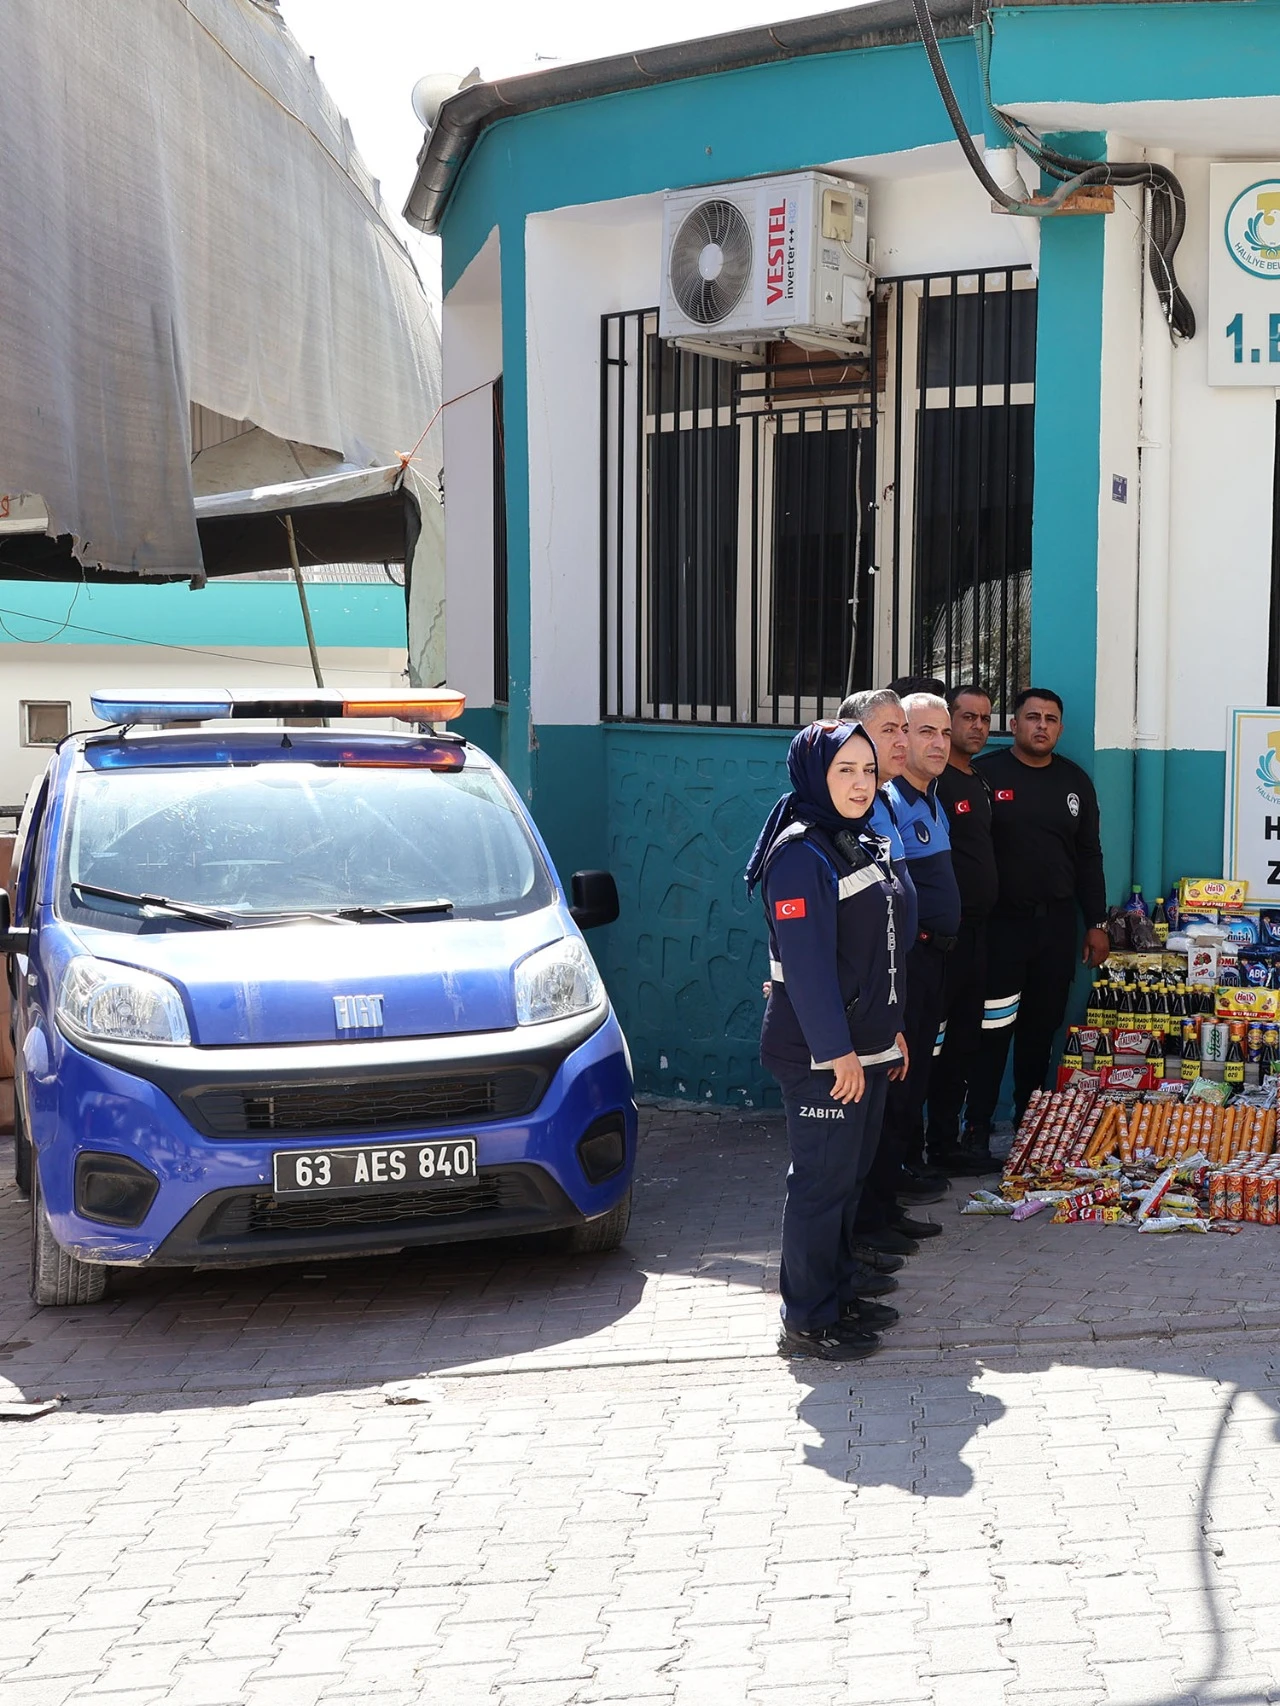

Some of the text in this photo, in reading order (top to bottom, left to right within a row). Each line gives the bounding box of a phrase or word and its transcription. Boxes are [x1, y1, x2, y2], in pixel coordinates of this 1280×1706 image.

[767, 198, 786, 305] VESTEL
[1235, 242, 1265, 269] HALİLİYE
[885, 895, 898, 1005] ZABITA
[332, 994, 386, 1029] FIAT
[798, 1106, 845, 1120] ZABITA
[295, 1146, 470, 1186] 63 AES 840
